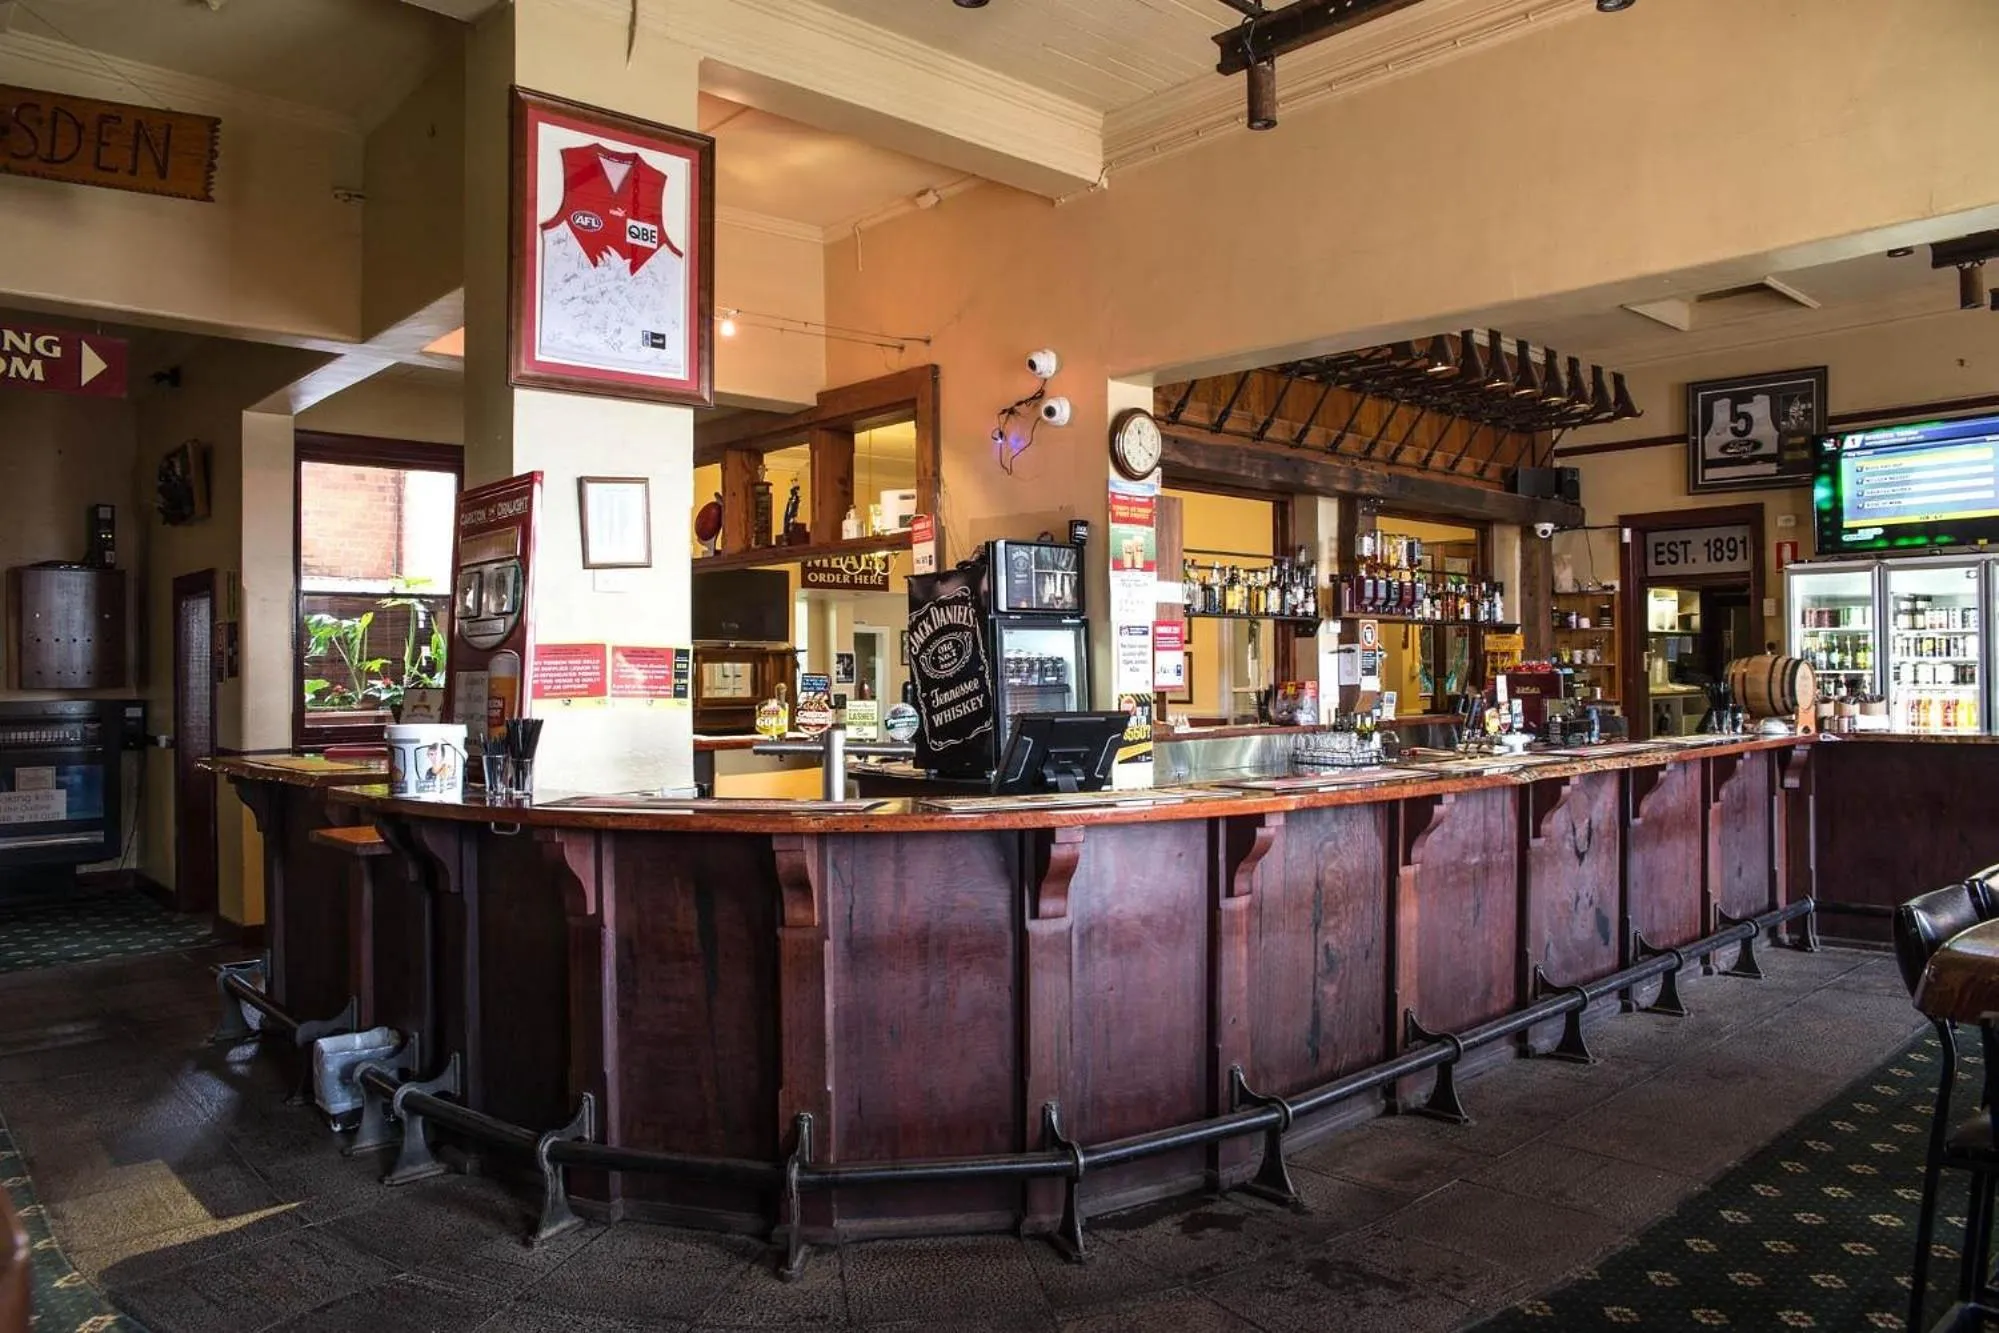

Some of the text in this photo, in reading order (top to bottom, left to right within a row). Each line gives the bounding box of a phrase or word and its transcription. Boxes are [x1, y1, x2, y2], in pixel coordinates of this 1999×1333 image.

[575, 214, 600, 228] AFL
[628, 224, 657, 244] QBE
[0, 356, 45, 381] M
[1730, 397, 1753, 437] 5
[1654, 535, 1748, 566] EST. 1891
[807, 572, 885, 585] ORDER HERE
[909, 616, 935, 655] JACK
[938, 641, 954, 655] Old
[930, 678, 980, 708] Tennessee
[848, 711, 875, 721] LASHES
[932, 694, 984, 728] WHISKEY
